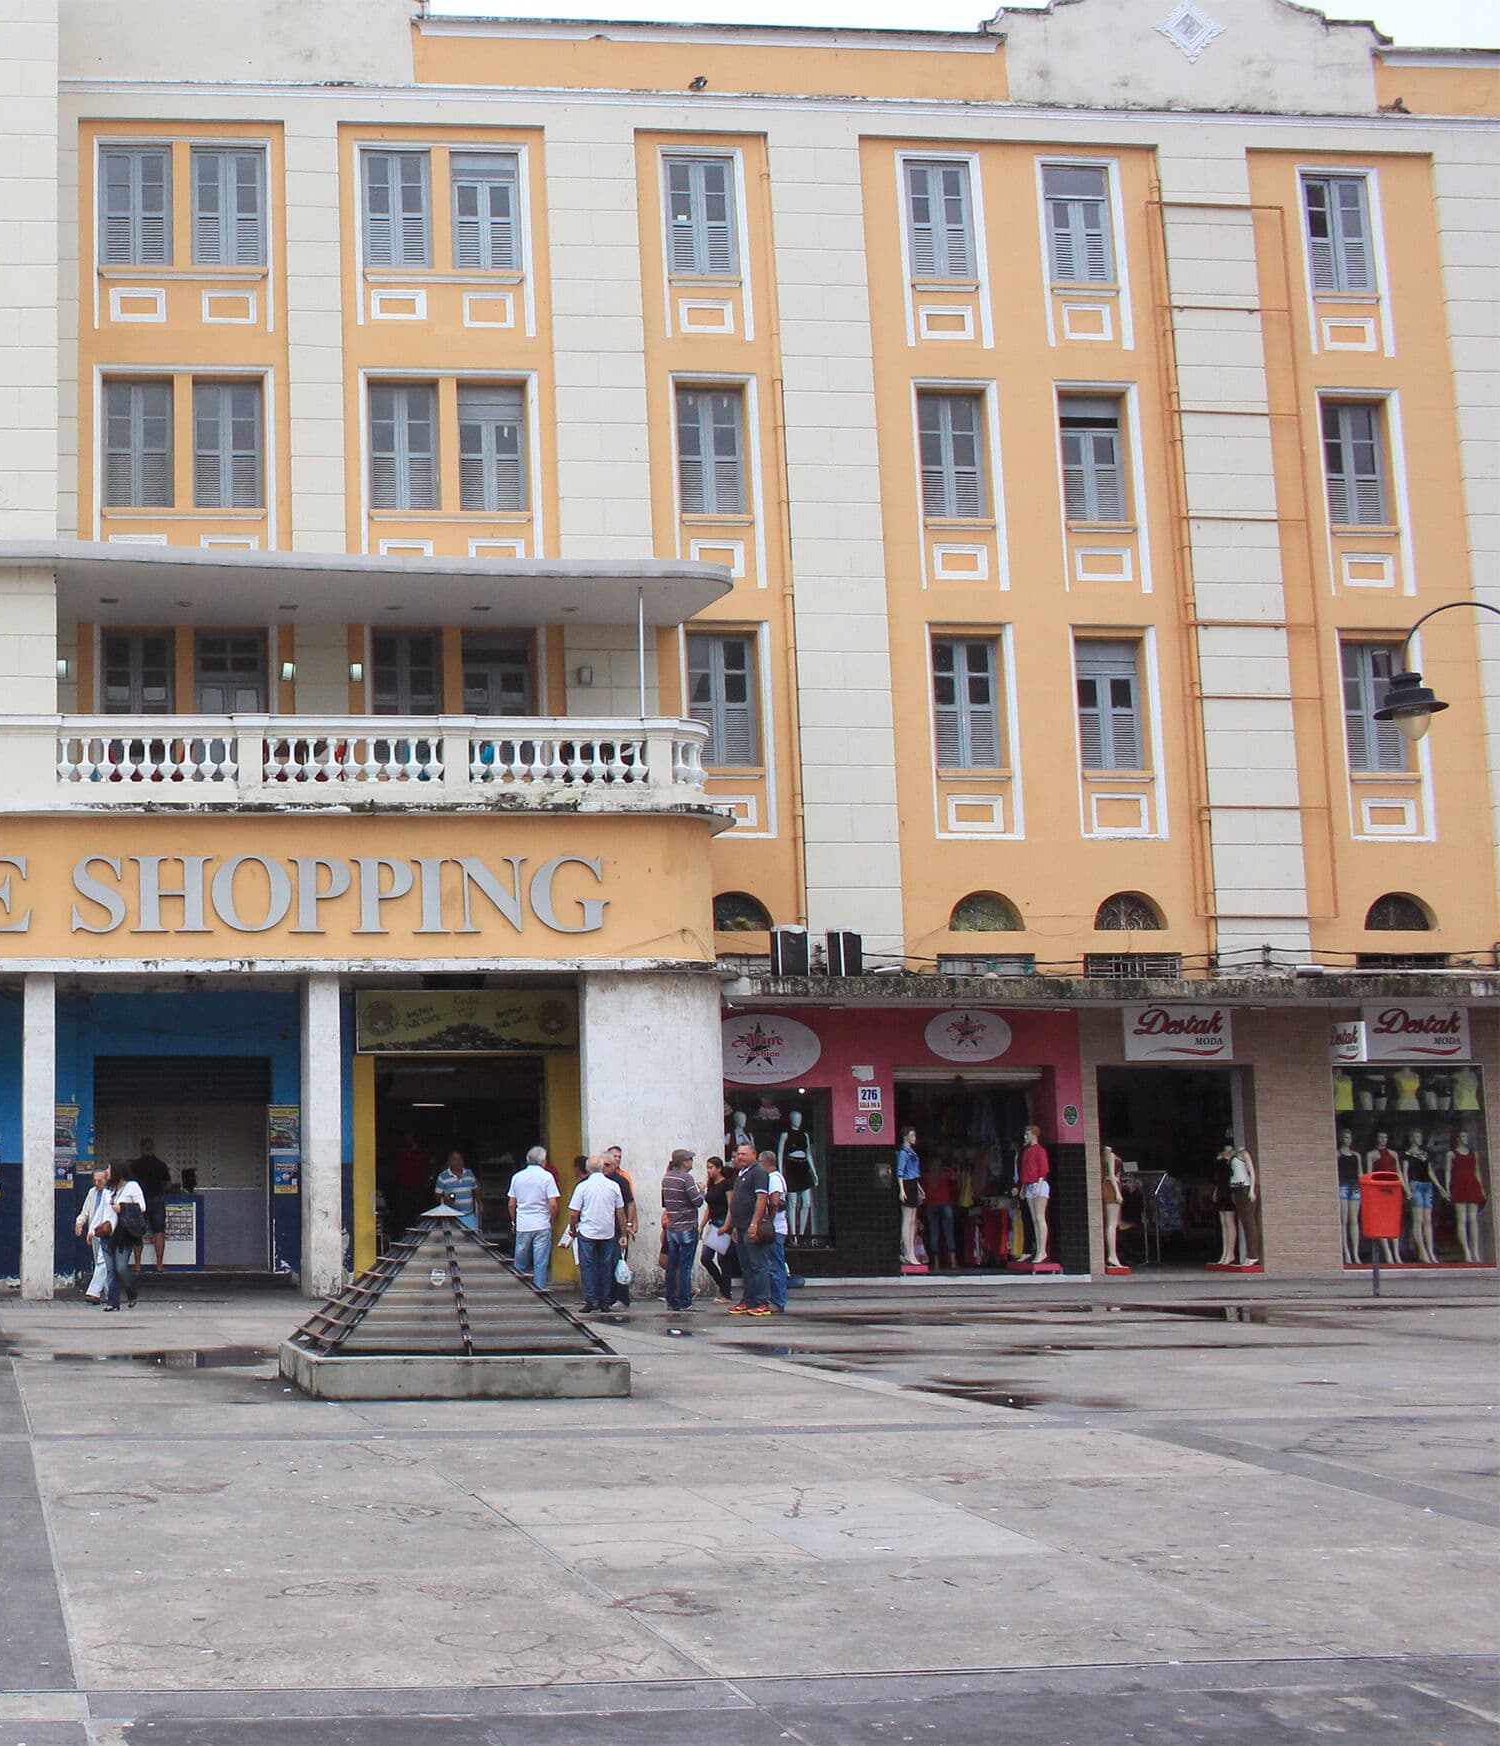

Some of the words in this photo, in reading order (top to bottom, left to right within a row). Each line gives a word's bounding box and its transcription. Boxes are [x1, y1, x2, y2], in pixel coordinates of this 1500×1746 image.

[71, 854, 610, 935] SHOPPING
[1133, 1008, 1223, 1036] Destak
[1372, 1008, 1461, 1035] Destak
[1195, 1037, 1223, 1046] MODA
[1433, 1037, 1461, 1045] MODA
[861, 1089, 878, 1101] 276
